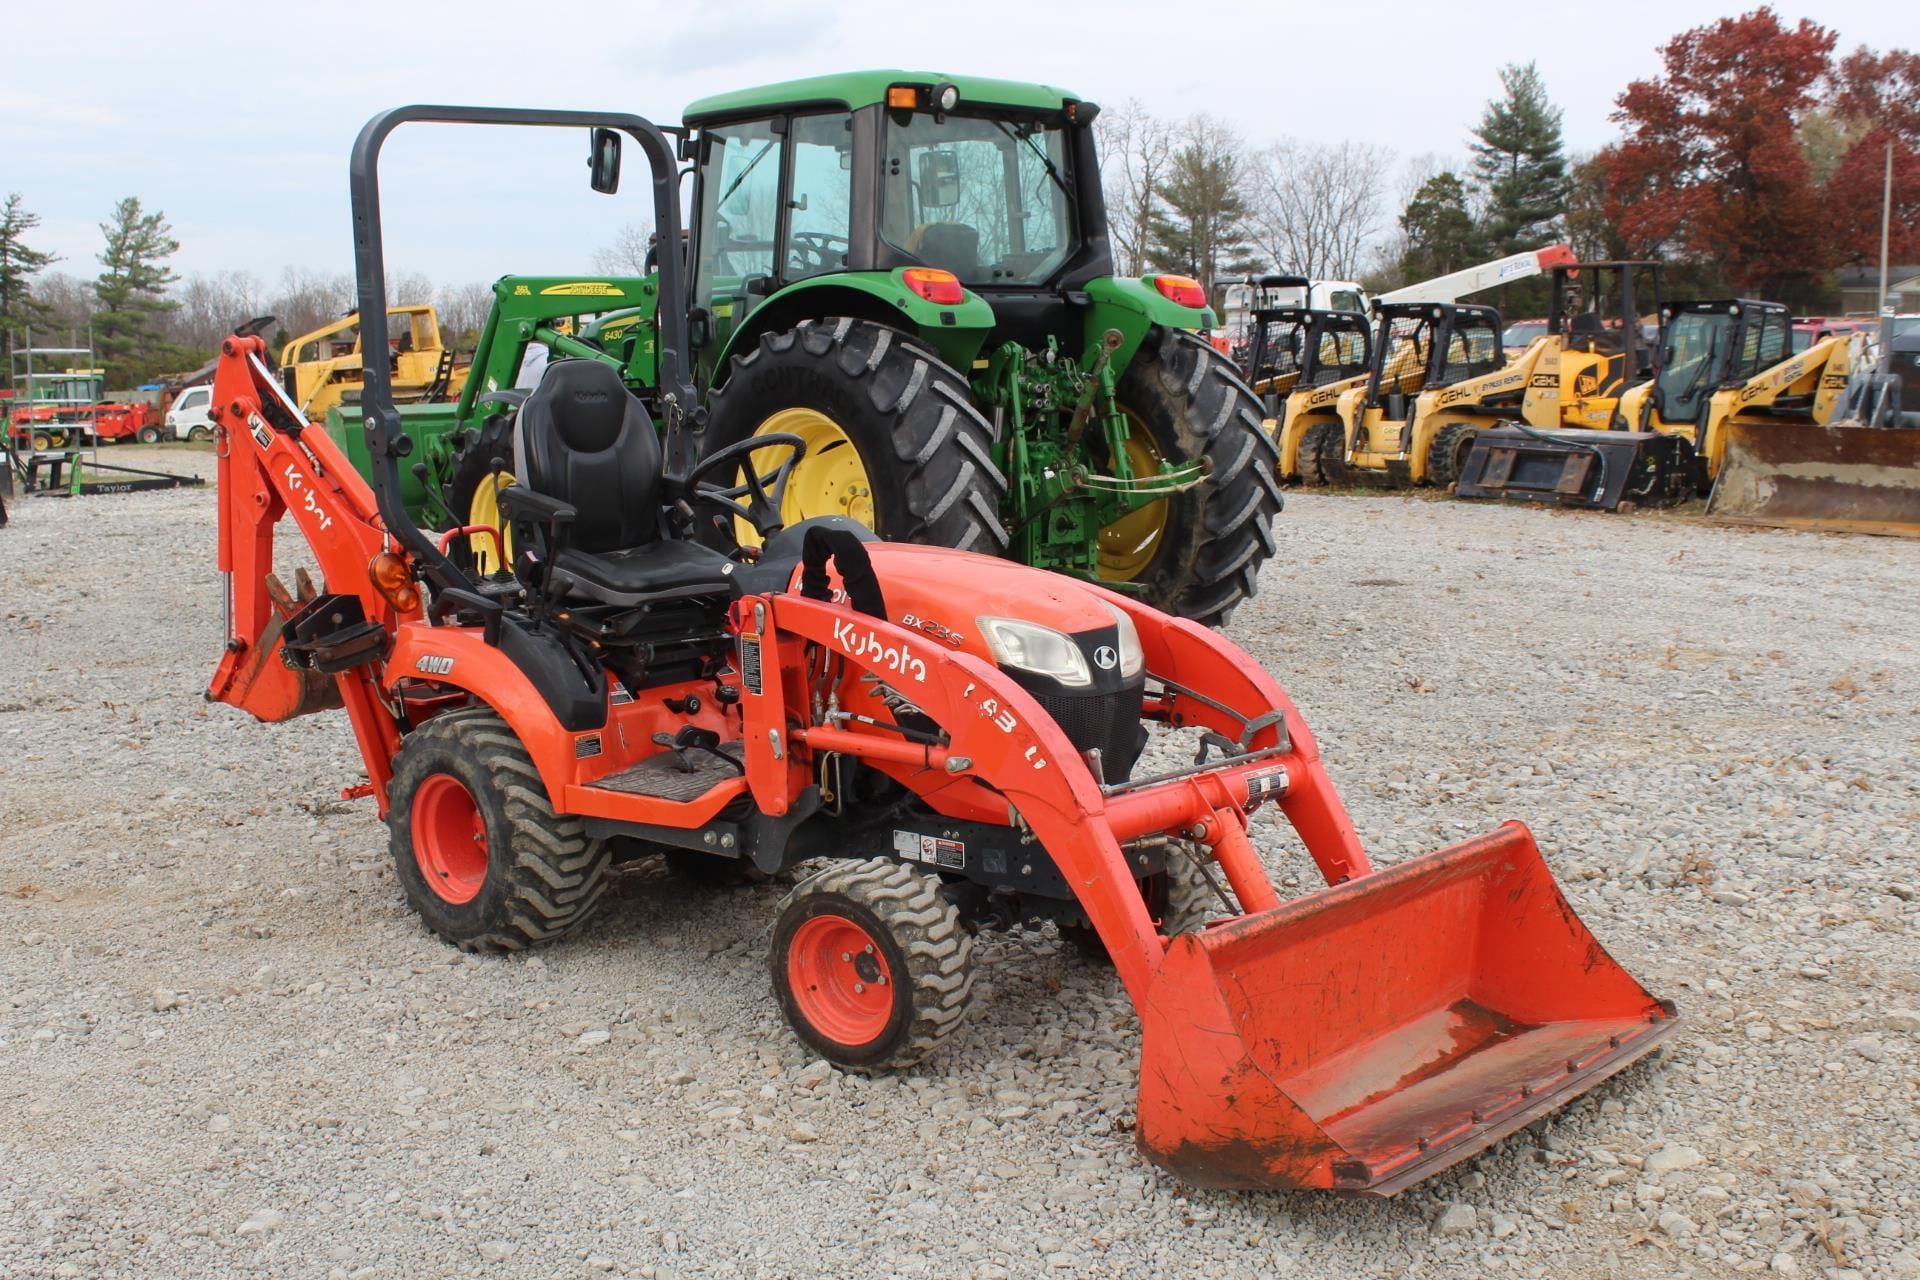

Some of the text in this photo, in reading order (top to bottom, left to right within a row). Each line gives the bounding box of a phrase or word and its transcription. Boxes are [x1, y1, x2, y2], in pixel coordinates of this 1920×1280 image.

[586, 285, 608, 295] DEERE
[604, 330, 623, 341] 6430
[1534, 375, 1560, 387] GEHL
[1310, 388, 1341, 405] GEHL
[1439, 387, 1471, 404] GEHL
[1740, 382, 1769, 402] GEHL
[96, 484, 133, 493] Taylor
[833, 617, 927, 683] Kubota
[416, 655, 455, 675] 4WD
